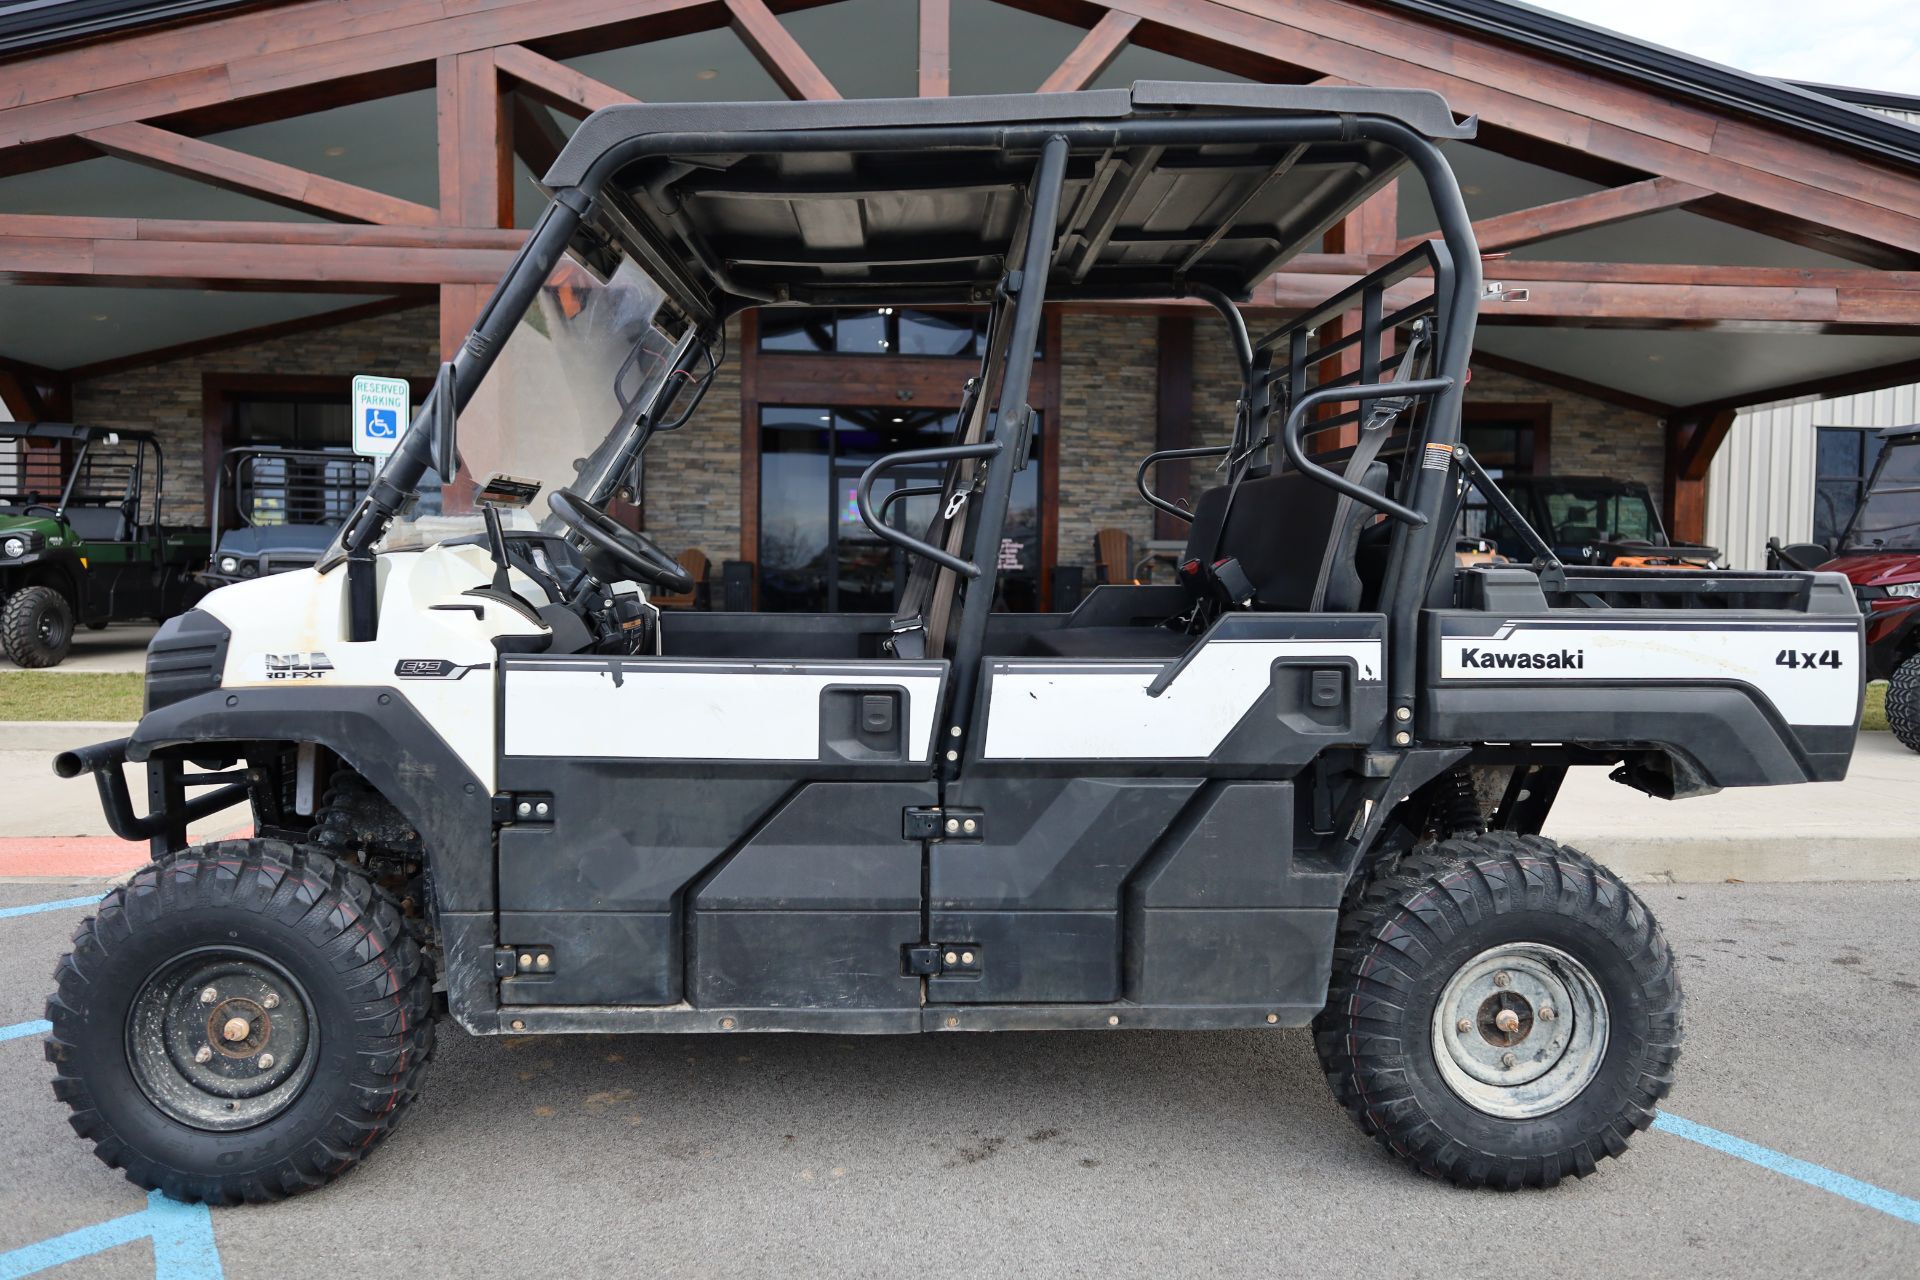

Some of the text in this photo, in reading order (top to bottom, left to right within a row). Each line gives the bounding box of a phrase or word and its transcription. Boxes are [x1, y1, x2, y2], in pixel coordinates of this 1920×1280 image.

[357, 382, 405, 395] RESERVED
[361, 394, 401, 407] PARKING
[265, 652, 335, 670] ULE
[1461, 647, 1584, 669] Kawasaki
[1775, 649, 1843, 669] 4x4
[266, 671, 326, 679] RO-FXT
